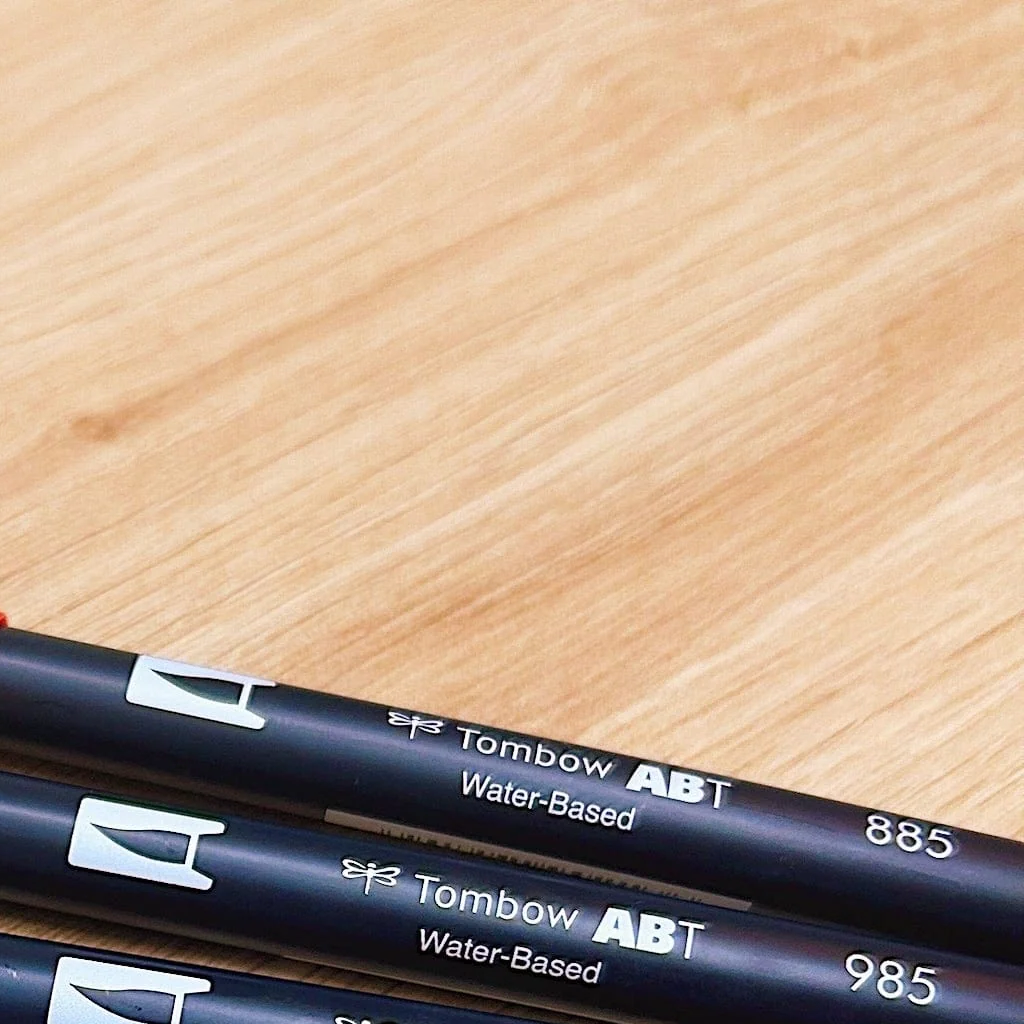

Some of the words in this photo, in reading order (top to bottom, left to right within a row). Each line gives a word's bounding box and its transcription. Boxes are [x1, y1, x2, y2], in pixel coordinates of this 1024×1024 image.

[456, 726, 613, 779] Tombow
[624, 763, 732, 809] ABT
[865, 814, 954, 859] 885
[462, 770, 637, 831] Water-Based
[414, 872, 581, 931] Tombow
[591, 907, 706, 960] ABT
[844, 953, 938, 1005] 985
[420, 928, 602, 984] Water-Based
